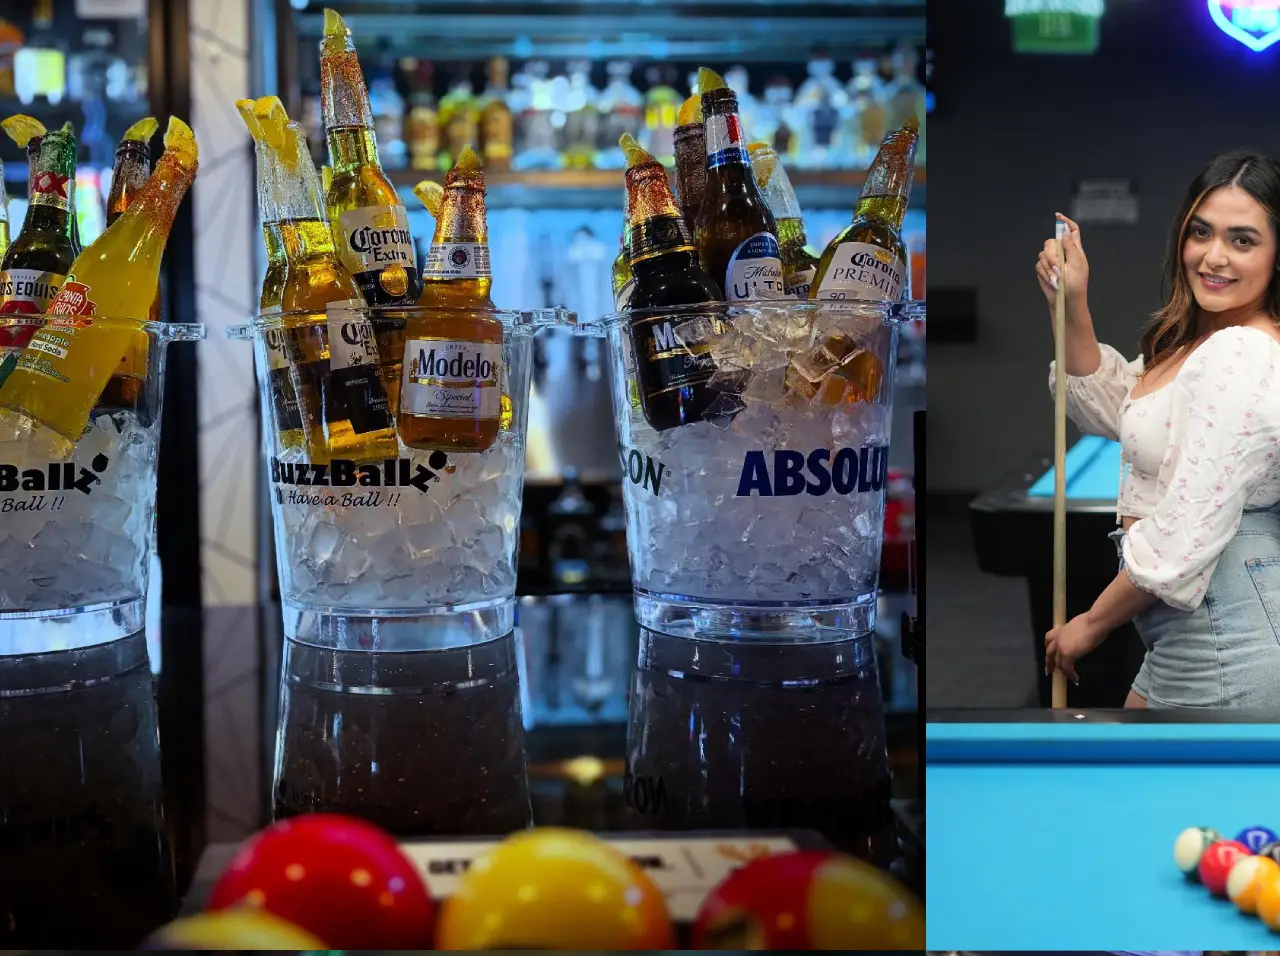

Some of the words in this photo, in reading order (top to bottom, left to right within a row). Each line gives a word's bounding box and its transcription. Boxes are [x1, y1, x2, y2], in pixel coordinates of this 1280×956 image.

[373, 246, 407, 262] Extra
[16, 281, 58, 300] EQUIS
[44, 343, 62, 357] Soda
[417, 348, 491, 379] Modelo
[1, 495, 47, 512] Ball
[288, 491, 323, 506] Have
[324, 493, 338, 506] a
[341, 490, 385, 507] Ball
